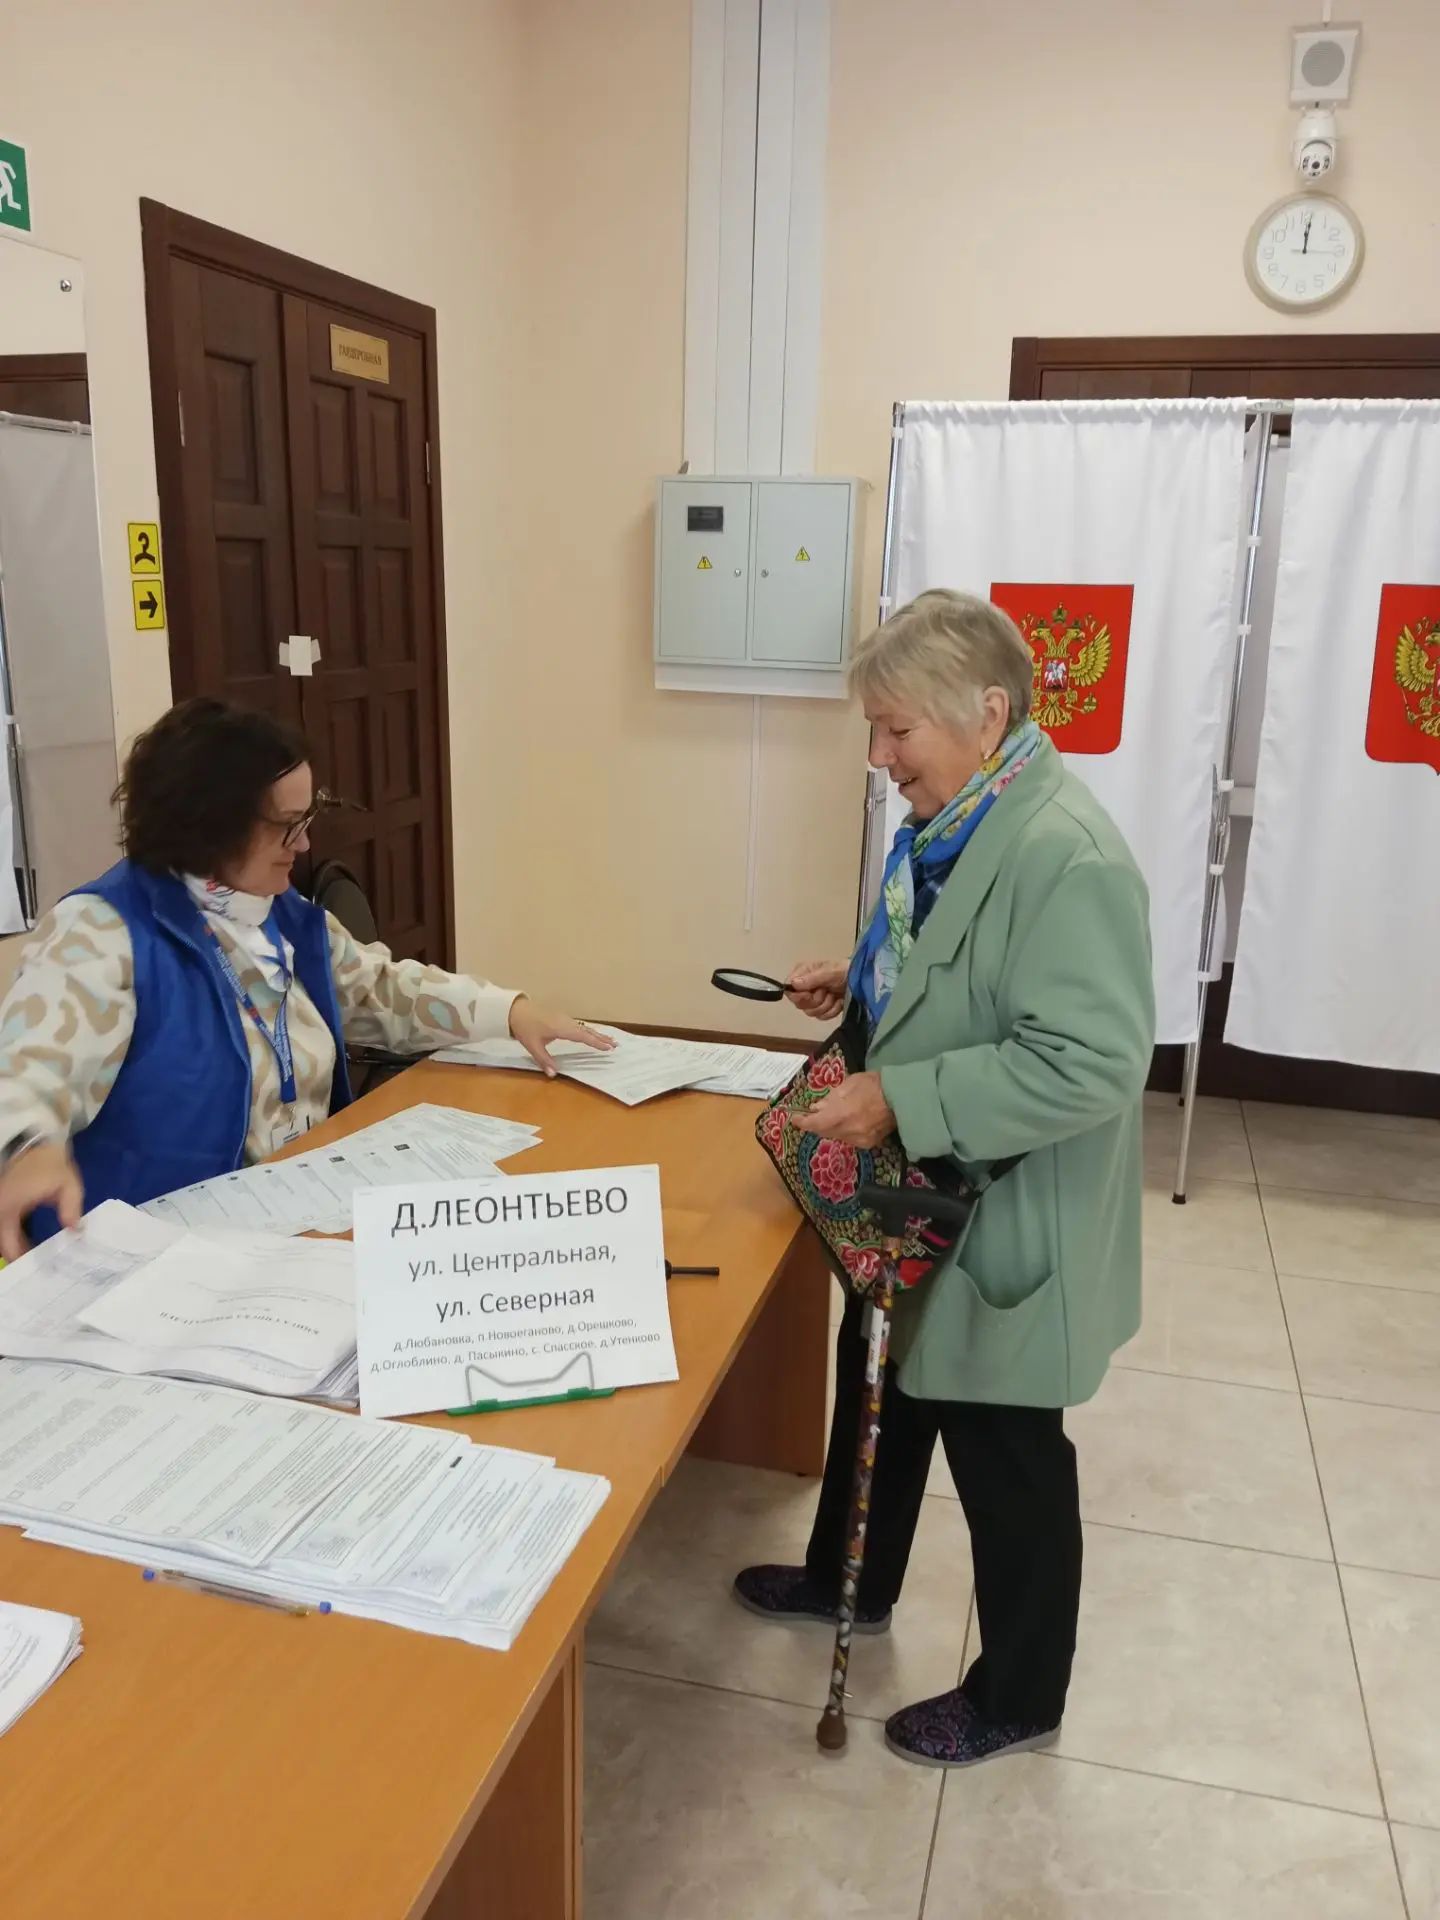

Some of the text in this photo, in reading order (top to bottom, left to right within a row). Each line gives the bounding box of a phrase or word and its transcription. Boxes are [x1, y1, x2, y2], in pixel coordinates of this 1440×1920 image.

[1271, 229, 1287, 244] 10
[1328, 227, 1343, 243] 2
[1264, 248, 1275, 260] 9
[1334, 246, 1345, 258] 3
[1280, 274, 1289, 289] 7
[1314, 274, 1326, 290] 5
[391, 1187, 628, 1237] Д.ЛЕОНТЬЕВО
[408, 1243, 617, 1282] ул. Центральная,
[436, 1287, 596, 1322] ул. Северная
[468, 1347, 528, 1361] Пасыкино,
